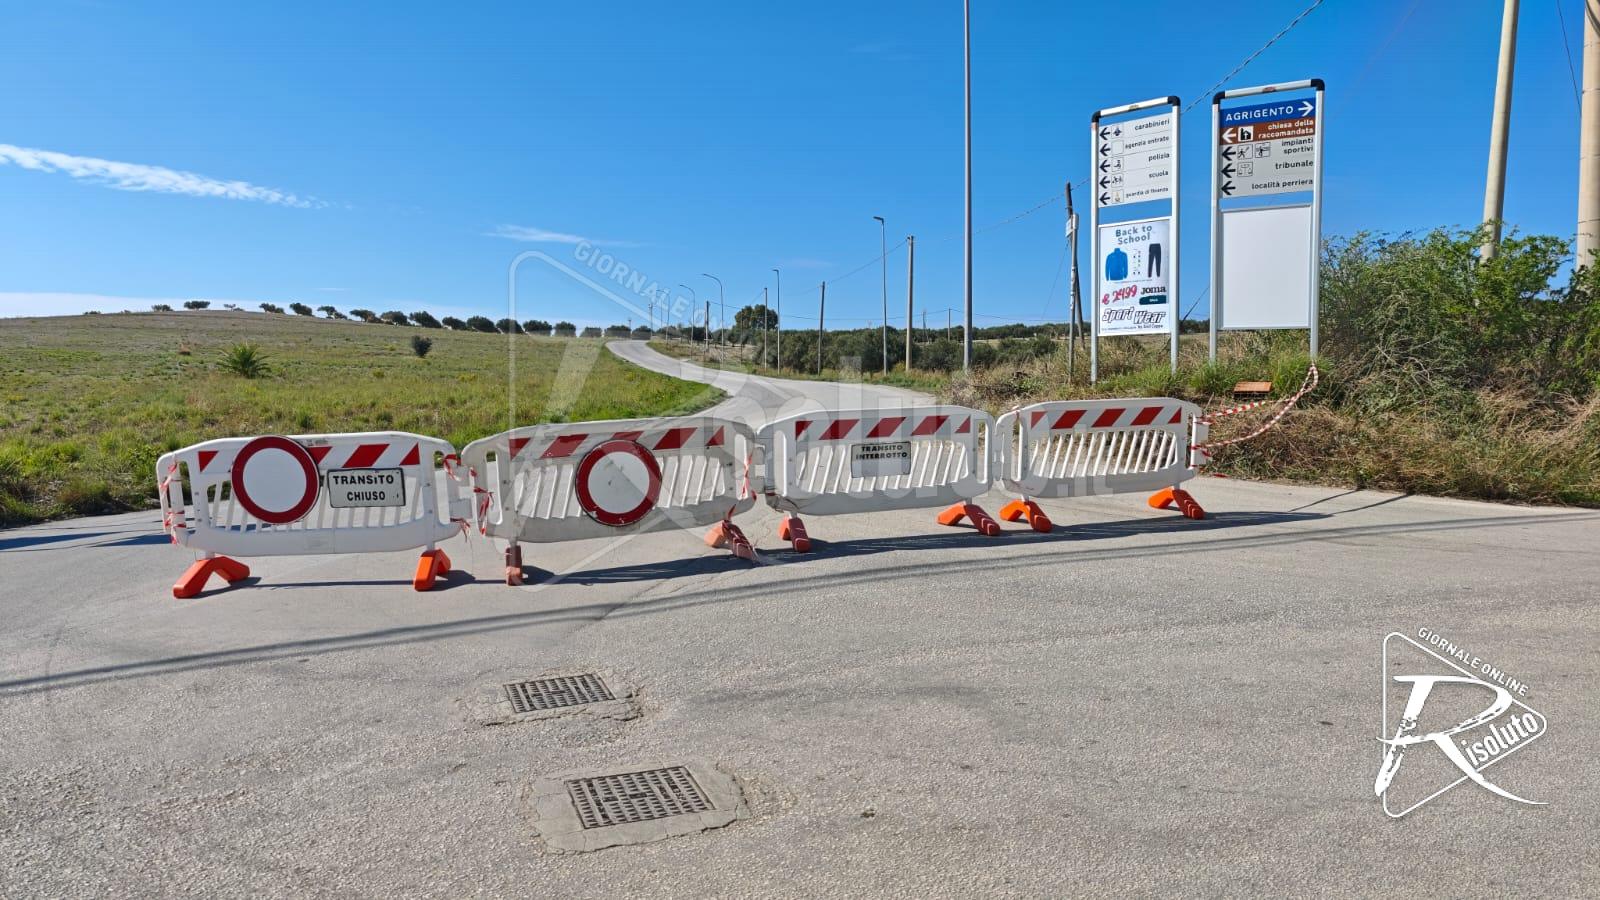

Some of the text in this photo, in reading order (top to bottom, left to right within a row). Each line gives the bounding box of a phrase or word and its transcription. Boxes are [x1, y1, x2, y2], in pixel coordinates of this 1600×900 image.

[1225, 106, 1294, 122] AGRIGENTO
[1134, 119, 1170, 131] carabinieri
[1267, 119, 1314, 130] chiesa della
[1258, 127, 1314, 139] raccomandata
[1125, 136, 1169, 150] agenzia entrate
[1281, 138, 1314, 147] impianti
[1283, 146, 1314, 155] sportivi
[1148, 152, 1170, 162] polizia
[1275, 160, 1314, 170] tribunale
[1148, 170, 1169, 178] scuola
[1251, 179, 1313, 190] località perriera
[1115, 226, 1139, 237] Back
[1117, 232, 1151, 245] School
[1102, 306, 1167, 325] Sport Wear
[861, 444, 903, 452] TRANSITO
[855, 452, 908, 460] INTERROTTO
[346, 491, 386, 501] CHIUSO
